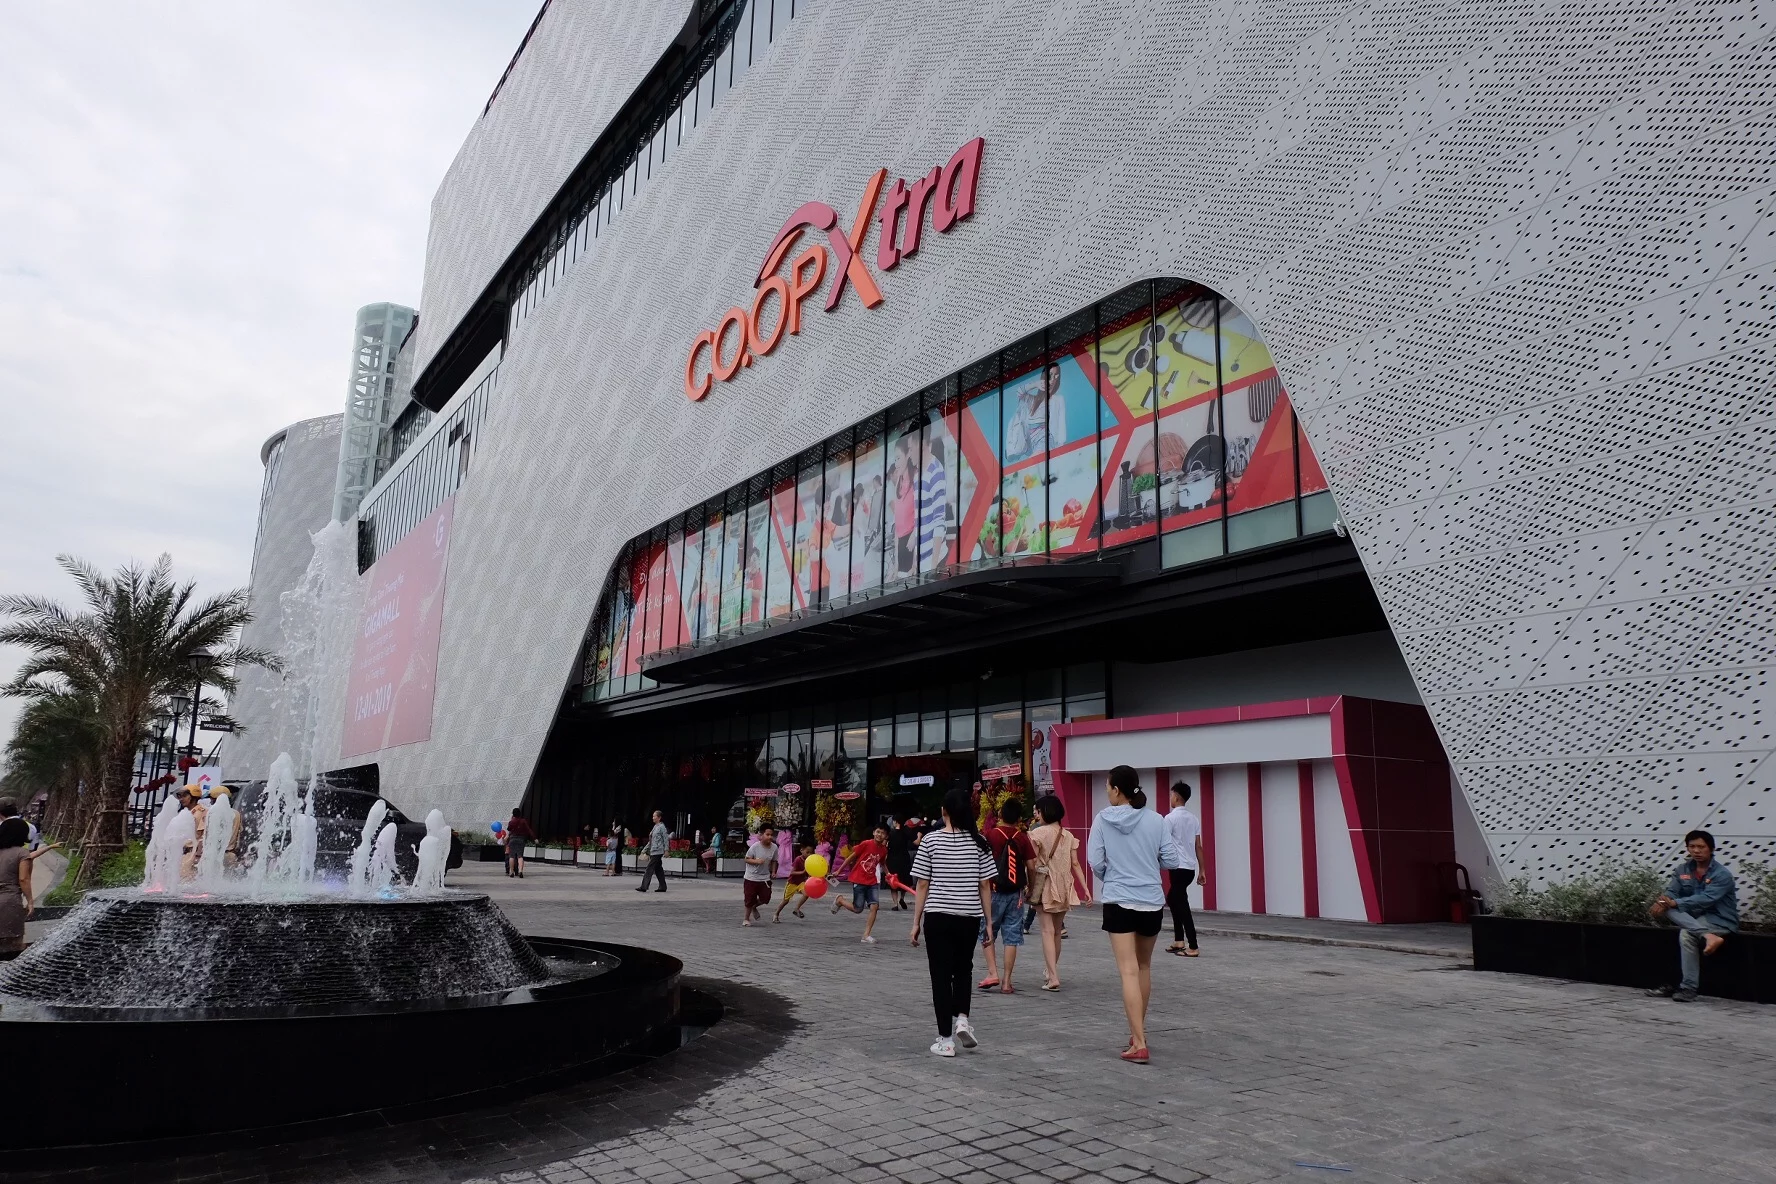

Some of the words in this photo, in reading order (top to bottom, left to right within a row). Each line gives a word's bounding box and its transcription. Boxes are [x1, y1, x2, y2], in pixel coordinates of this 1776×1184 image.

[364, 595, 400, 638] GIGAMALL
[355, 682, 392, 722] 12-01-2019
[1007, 844, 1017, 884] DMT
